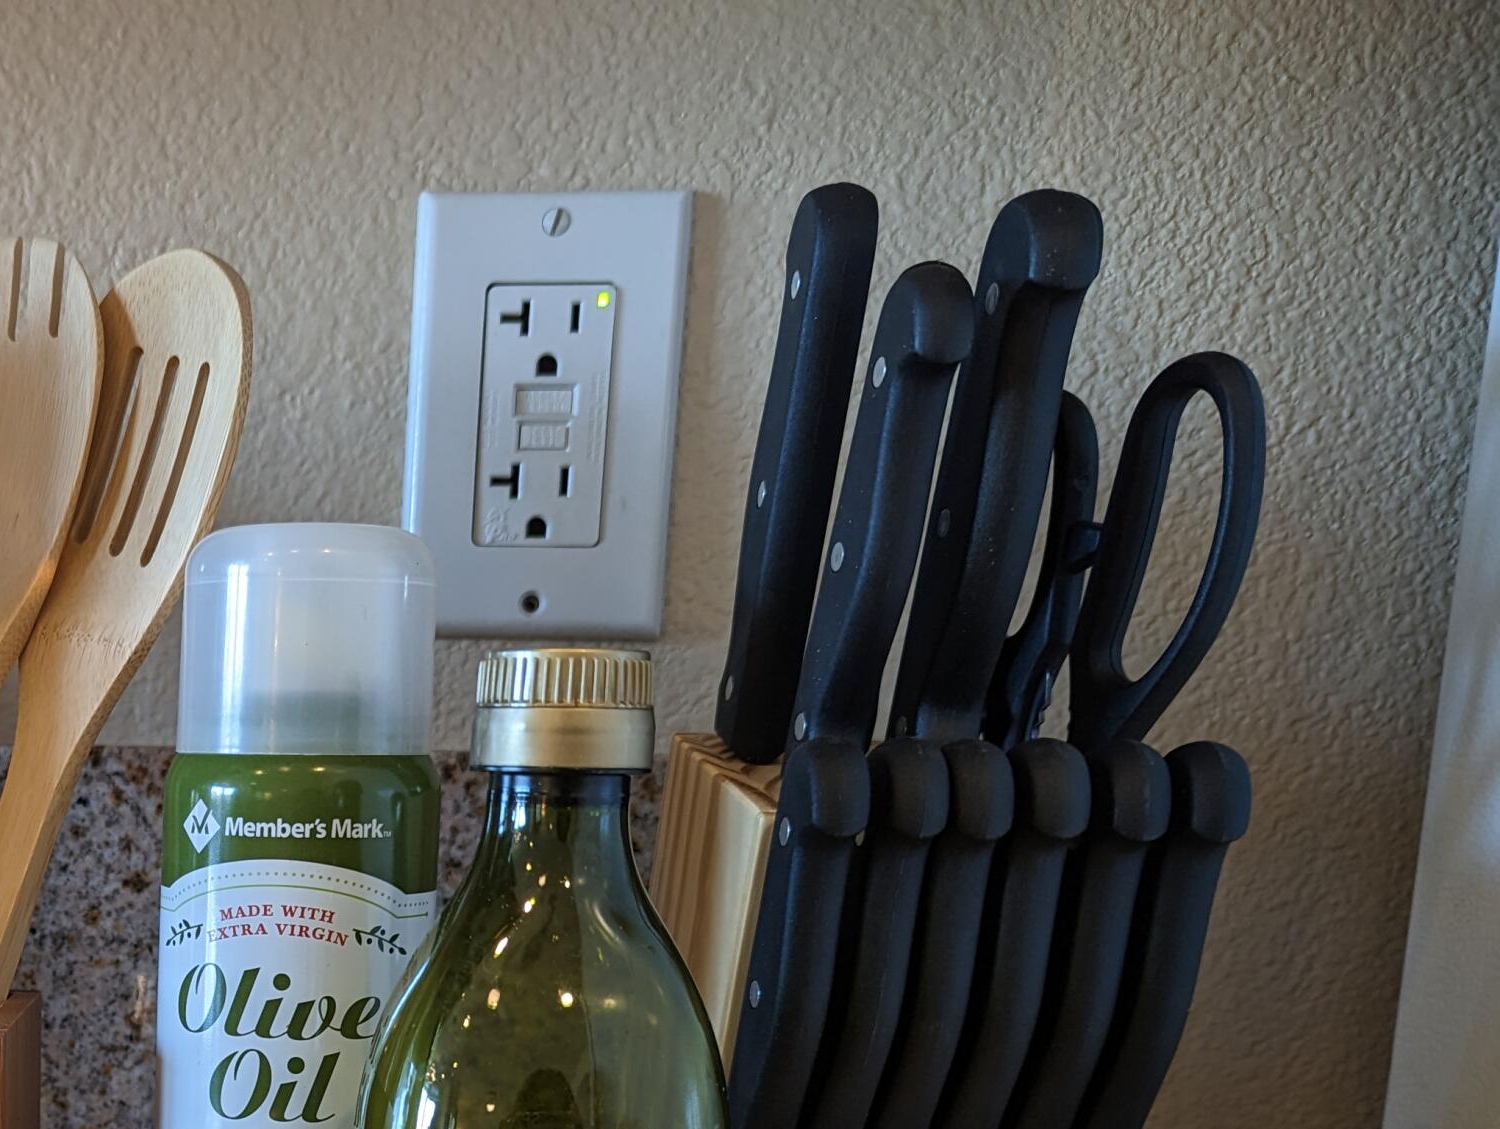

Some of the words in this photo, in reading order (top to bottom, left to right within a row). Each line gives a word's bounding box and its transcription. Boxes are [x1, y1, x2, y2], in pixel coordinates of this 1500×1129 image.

[224, 816, 327, 838] Member's
[331, 818, 383, 839] Mark
[219, 904, 273, 922] MADE
[281, 905, 336, 924] WITH
[207, 923, 268, 943] EXTRA
[275, 923, 349, 946] VIRGIN
[178, 962, 381, 1041] Olive
[209, 1048, 341, 1123] Oil
